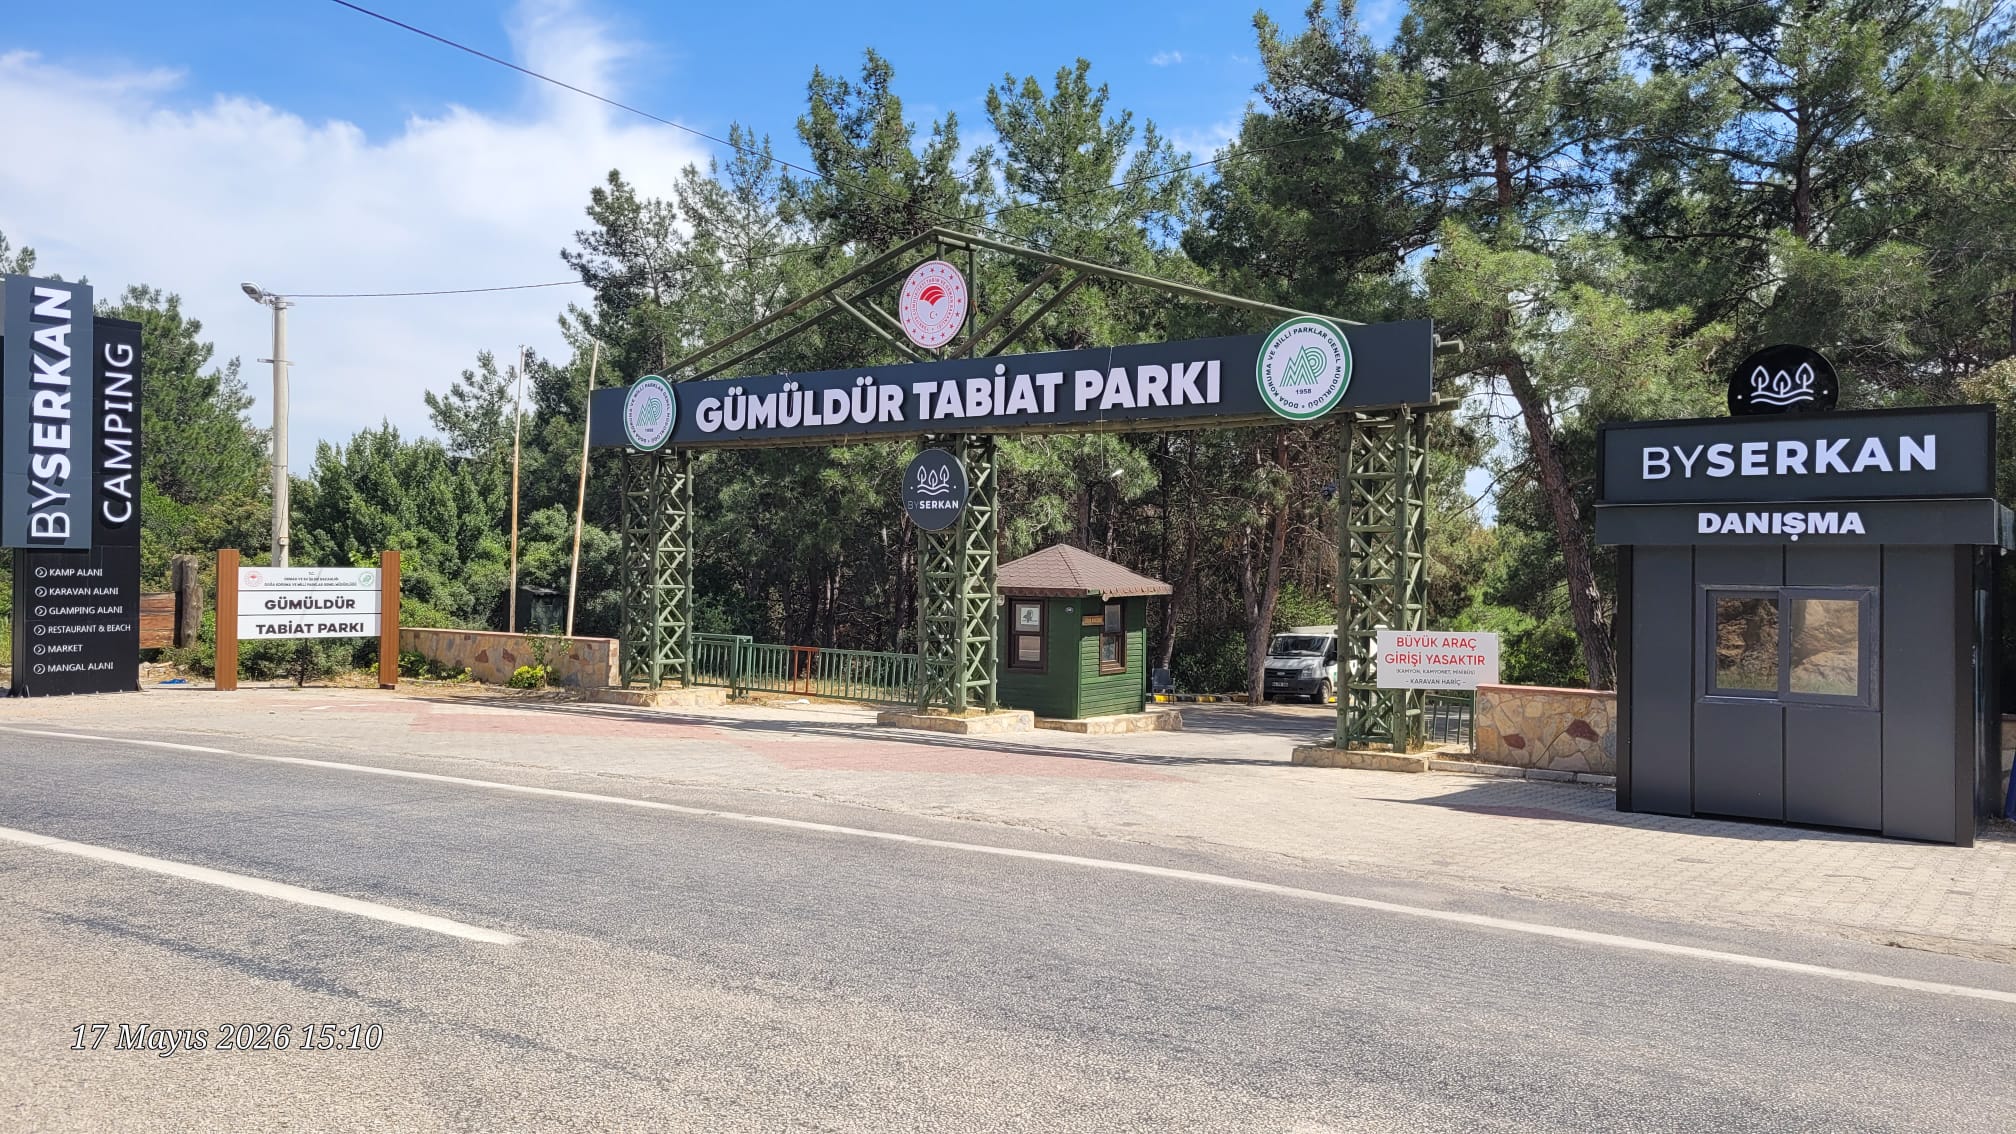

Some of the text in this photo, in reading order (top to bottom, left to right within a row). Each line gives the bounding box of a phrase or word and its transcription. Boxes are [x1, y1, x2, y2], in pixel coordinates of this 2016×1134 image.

[1294, 327, 1327, 339] PARKLAR
[1268, 351, 1275, 360] VE
[1328, 338, 1341, 362] GENEL
[1266, 364, 1280, 397] KORUMA
[696, 377, 904, 432] GÜMÜLDÜR
[913, 364, 1063, 420] TABİAT
[1075, 360, 1220, 411] PARKI
[32, 286, 72, 538] BYSERKAN
[103, 343, 134, 523] CAMPING
[1642, 435, 1936, 479] BYSERKAN
[908, 500, 958, 509] BYSERKAN
[1698, 512, 1866, 541] DANIŞMA
[49, 568, 103, 576] KAMP ALANI
[93, 587, 118, 595] ALANI
[264, 596, 356, 610] GÜMÜLDÜR
[49, 606, 123, 615] GLAMPING ALANI
[48, 625, 97, 633] RESTAURANT
[107, 624, 131, 632] BEACH
[256, 620, 364, 634] TABİAT PARKI
[48, 644, 83, 653] MARKET
[1397, 635, 1477, 651] BÜYÜK ARAÇ
[1385, 651, 1485, 667] GİRİŞİ YASAKTIR
[48, 662, 113, 672] MANGAL ALANI
[1442, 678, 1460, 686] HARİÇ
